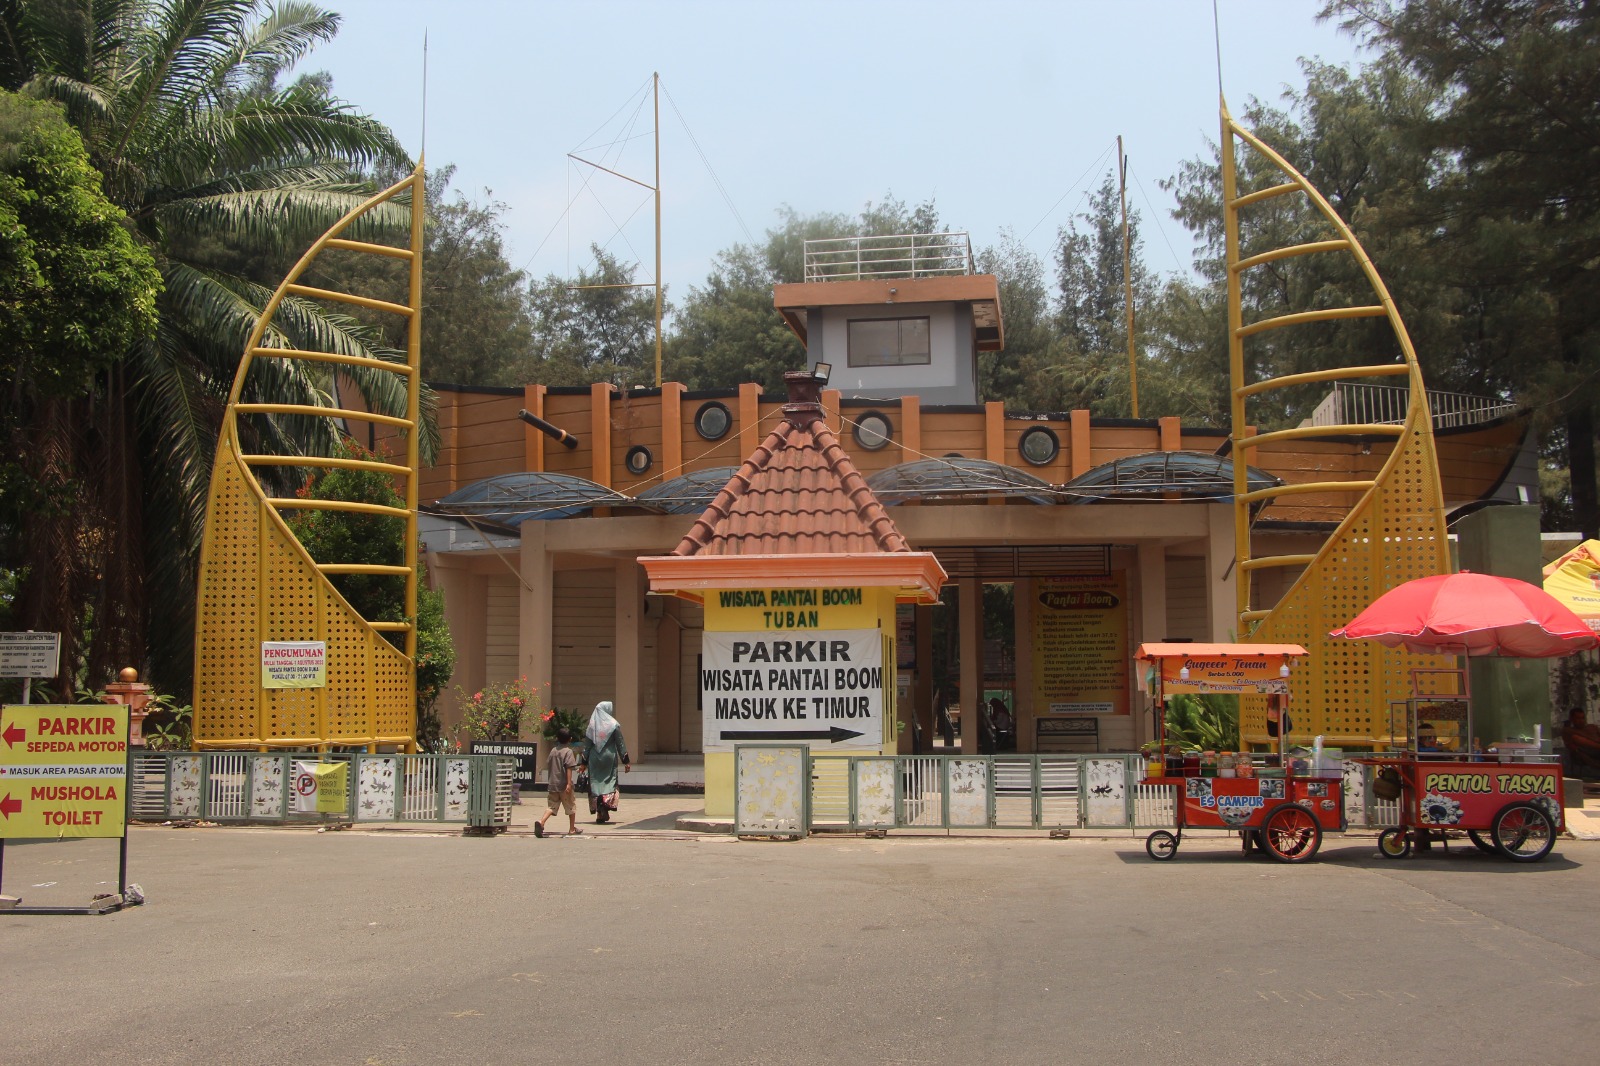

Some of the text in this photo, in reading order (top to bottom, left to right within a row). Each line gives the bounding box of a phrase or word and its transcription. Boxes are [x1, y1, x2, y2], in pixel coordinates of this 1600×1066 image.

[720, 588, 862, 607] WISATA PANTAI BOOM
[1047, 593, 1112, 606] Pantai Boom
[764, 611, 818, 628] TUBAN
[264, 648, 324, 658] PENGUMUMAN
[732, 640, 851, 663] PARKIR
[1231, 658, 1267, 670] Tenan
[703, 667, 882, 691] WISATA PANTAI BOOM
[715, 696, 870, 719] MASUK KE TIMUR
[38, 717, 116, 735] PARKIR
[27, 741, 126, 752] SEPEDA MOTOR
[474, 745, 533, 755] PARKIR KHUSUS
[9, 767, 40, 775] MASUK
[42, 767, 66, 775] AREA
[68, 767, 96, 775] PASAR
[1425, 773, 1557, 795] PENTOL TASYA
[31, 786, 117, 801] MUSHOLA
[1200, 795, 1265, 808] ES CAMPUR
[43, 810, 103, 826] TOILET
